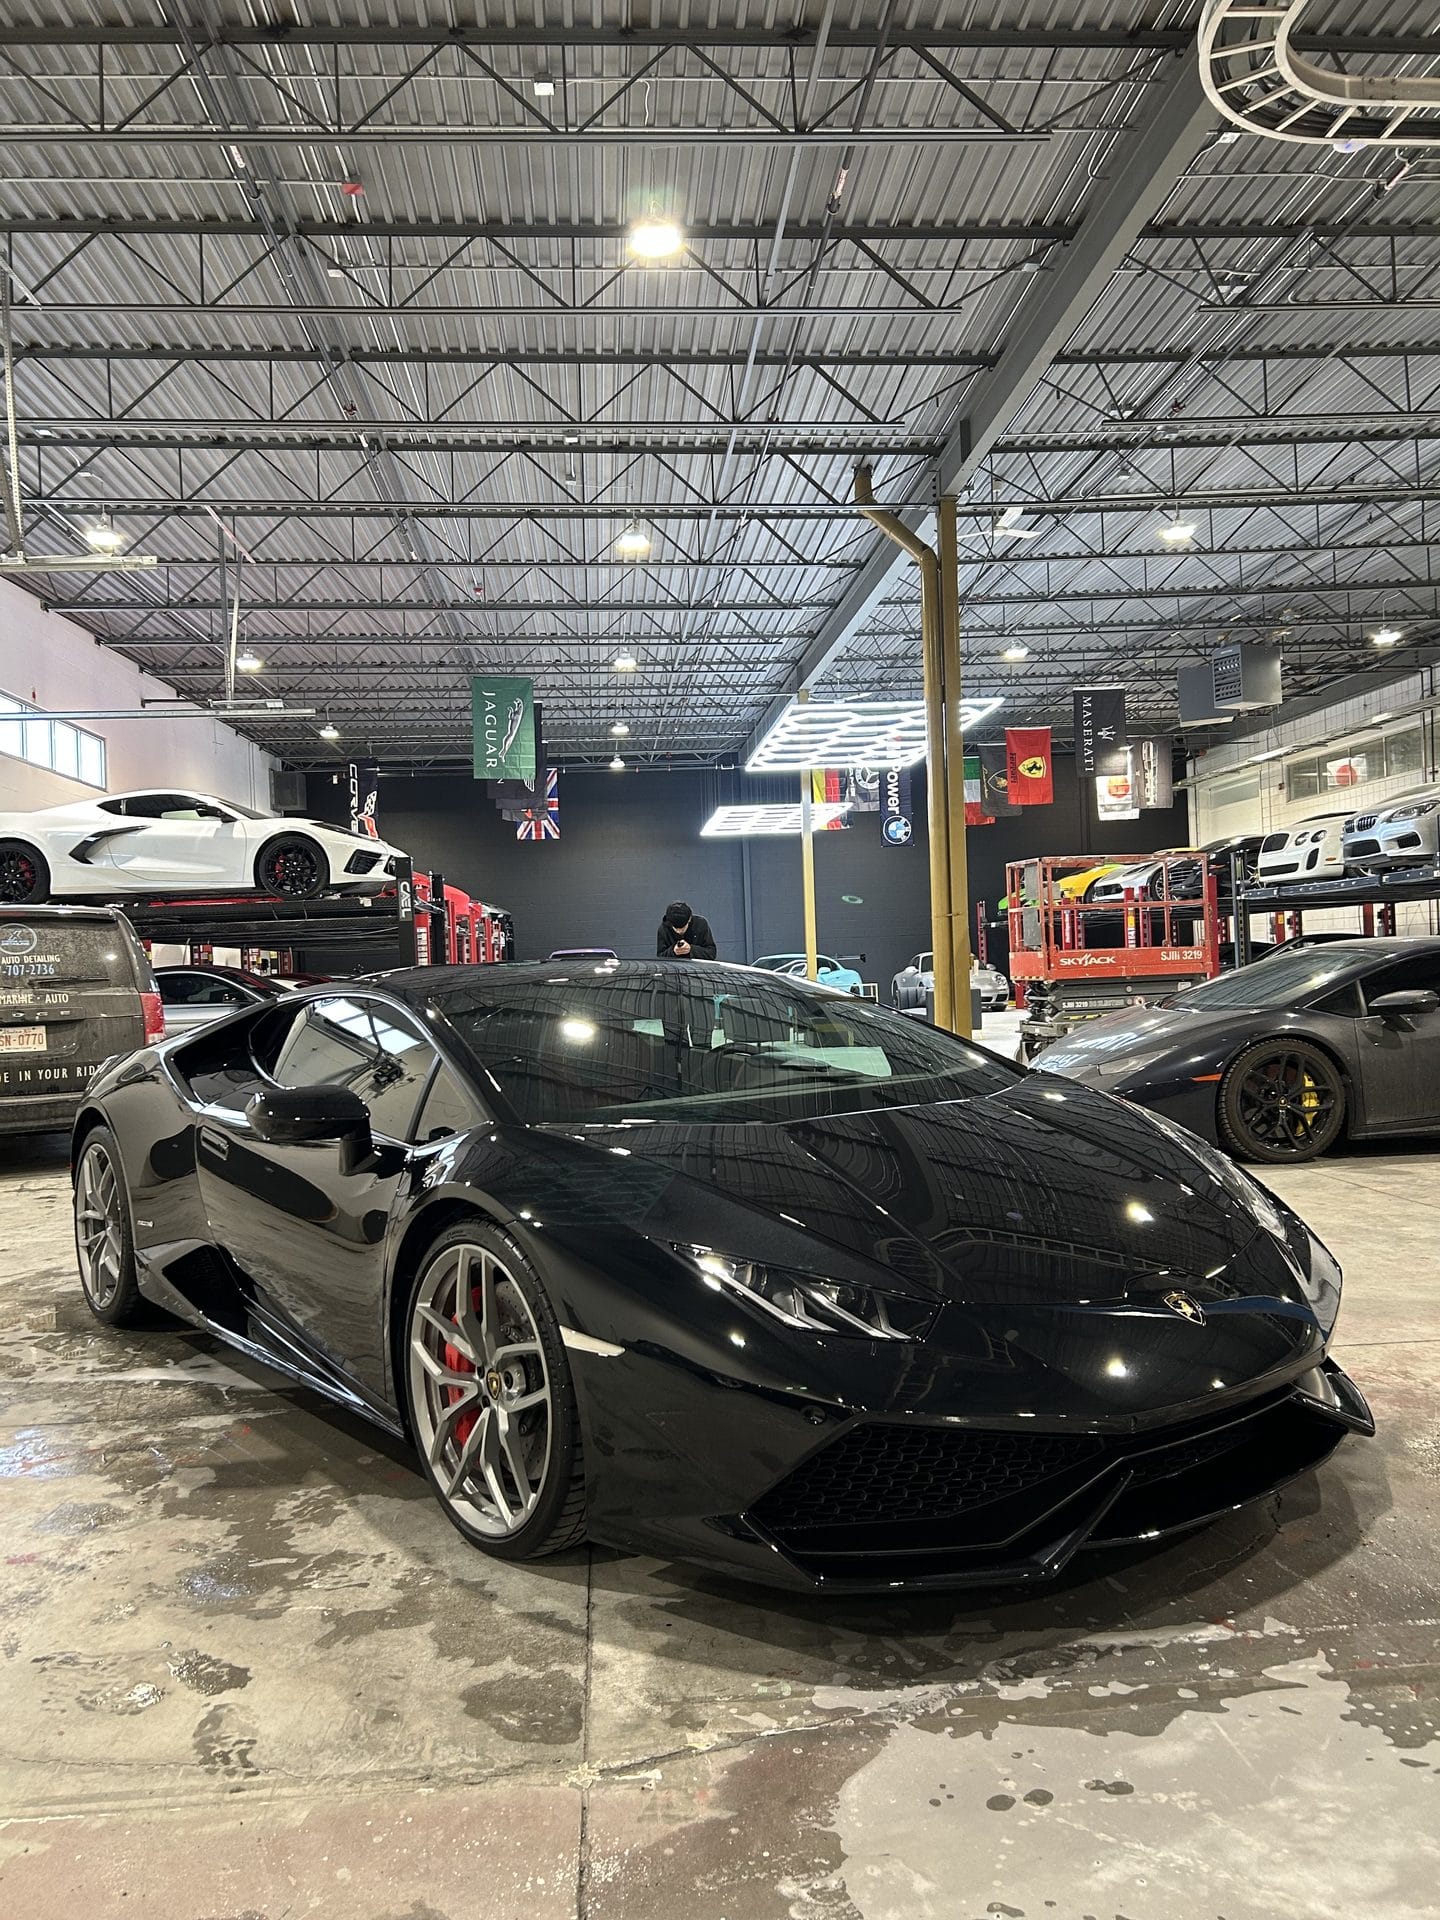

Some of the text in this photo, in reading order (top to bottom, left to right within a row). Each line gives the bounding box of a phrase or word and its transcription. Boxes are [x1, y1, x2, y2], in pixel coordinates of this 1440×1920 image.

[482, 691, 499, 768] JAGUAR
[1081, 695, 1094, 772] MASERATI
[400, 881, 412, 918] CAEL
[2, 955, 61, 965] AUTO DETAILING
[1059, 953, 1117, 967] SKYJACK
[1182, 950, 1202, 960] 3219
[45, 993, 69, 1004] AUTO
[19, 1070, 31, 1082] IN
[38, 1068, 68, 1080] YOUR
